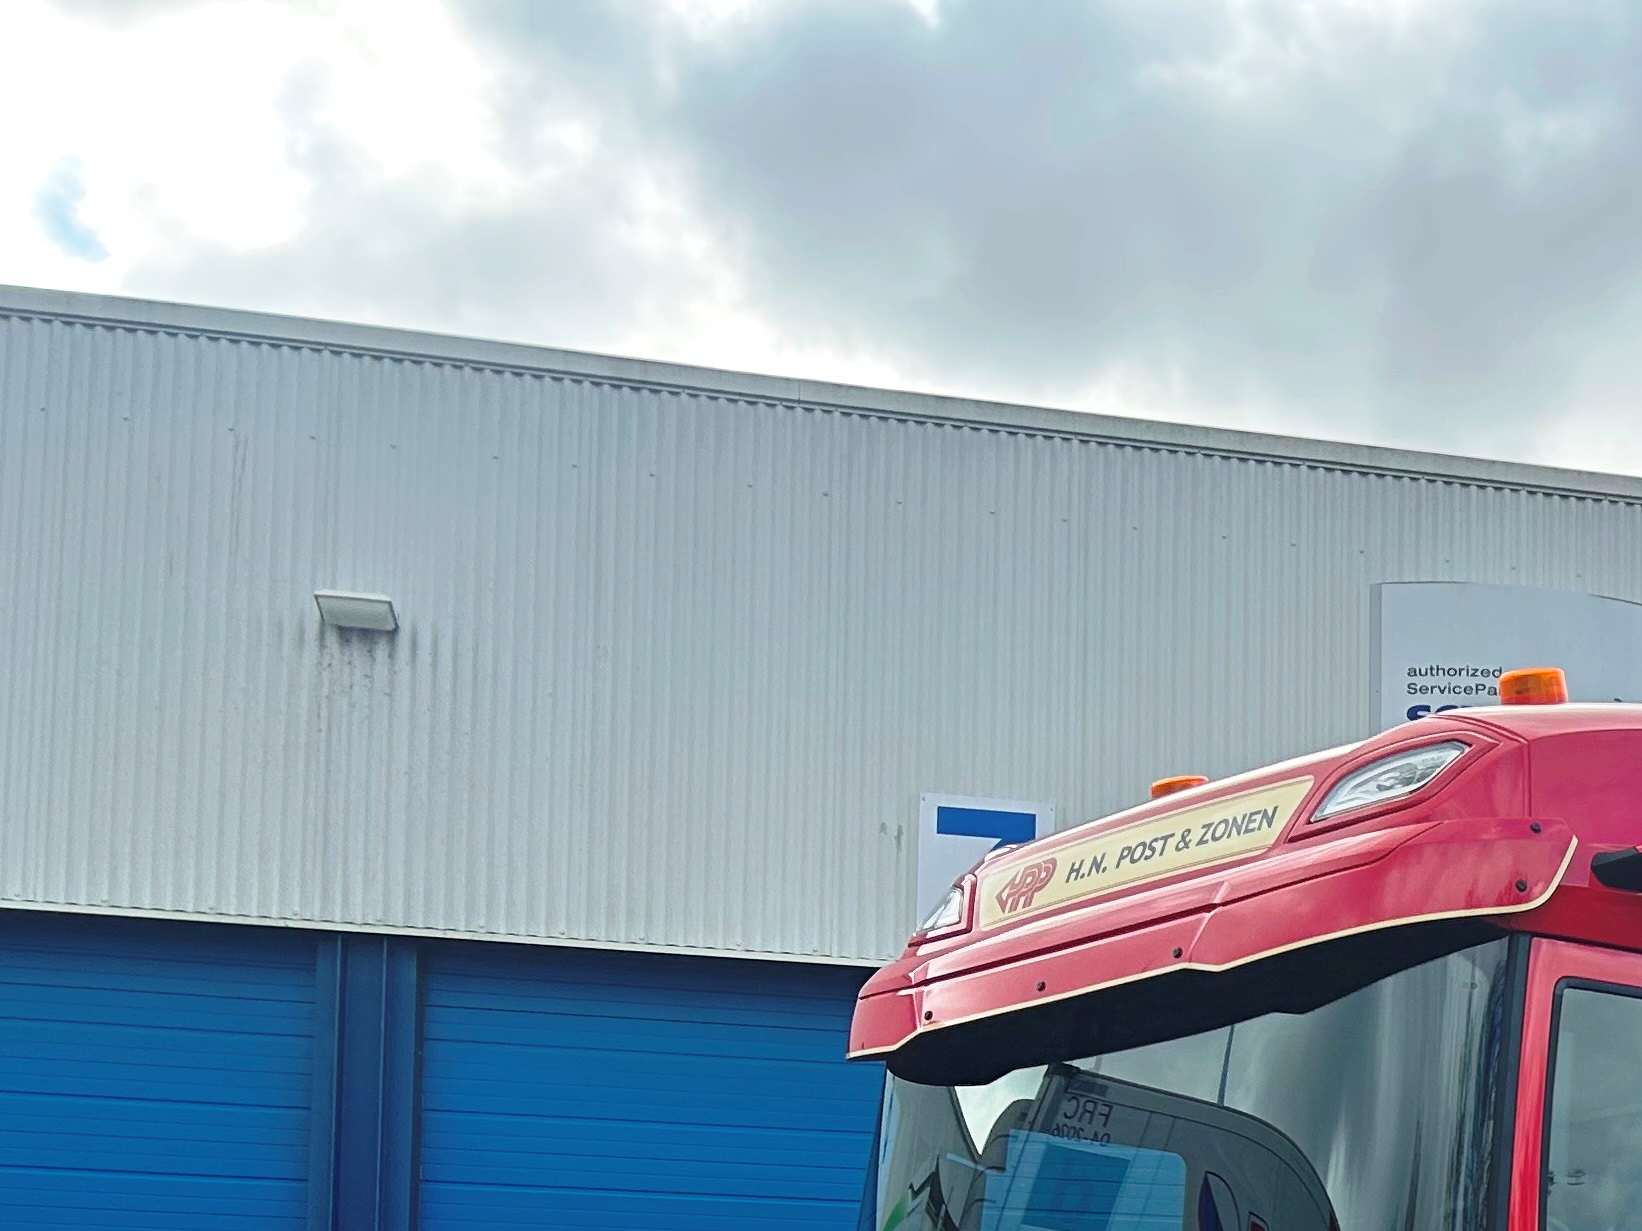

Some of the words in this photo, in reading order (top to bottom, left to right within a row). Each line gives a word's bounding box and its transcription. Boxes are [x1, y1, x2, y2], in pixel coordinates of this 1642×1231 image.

[1406, 664, 1503, 679] authorized
[1406, 682, 1499, 696] ServicePa
[1065, 852, 1108, 884] H.N.
[1116, 829, 1177, 869] POST
[1175, 829, 1193, 853] &
[1196, 806, 1279, 846] ZONEN
